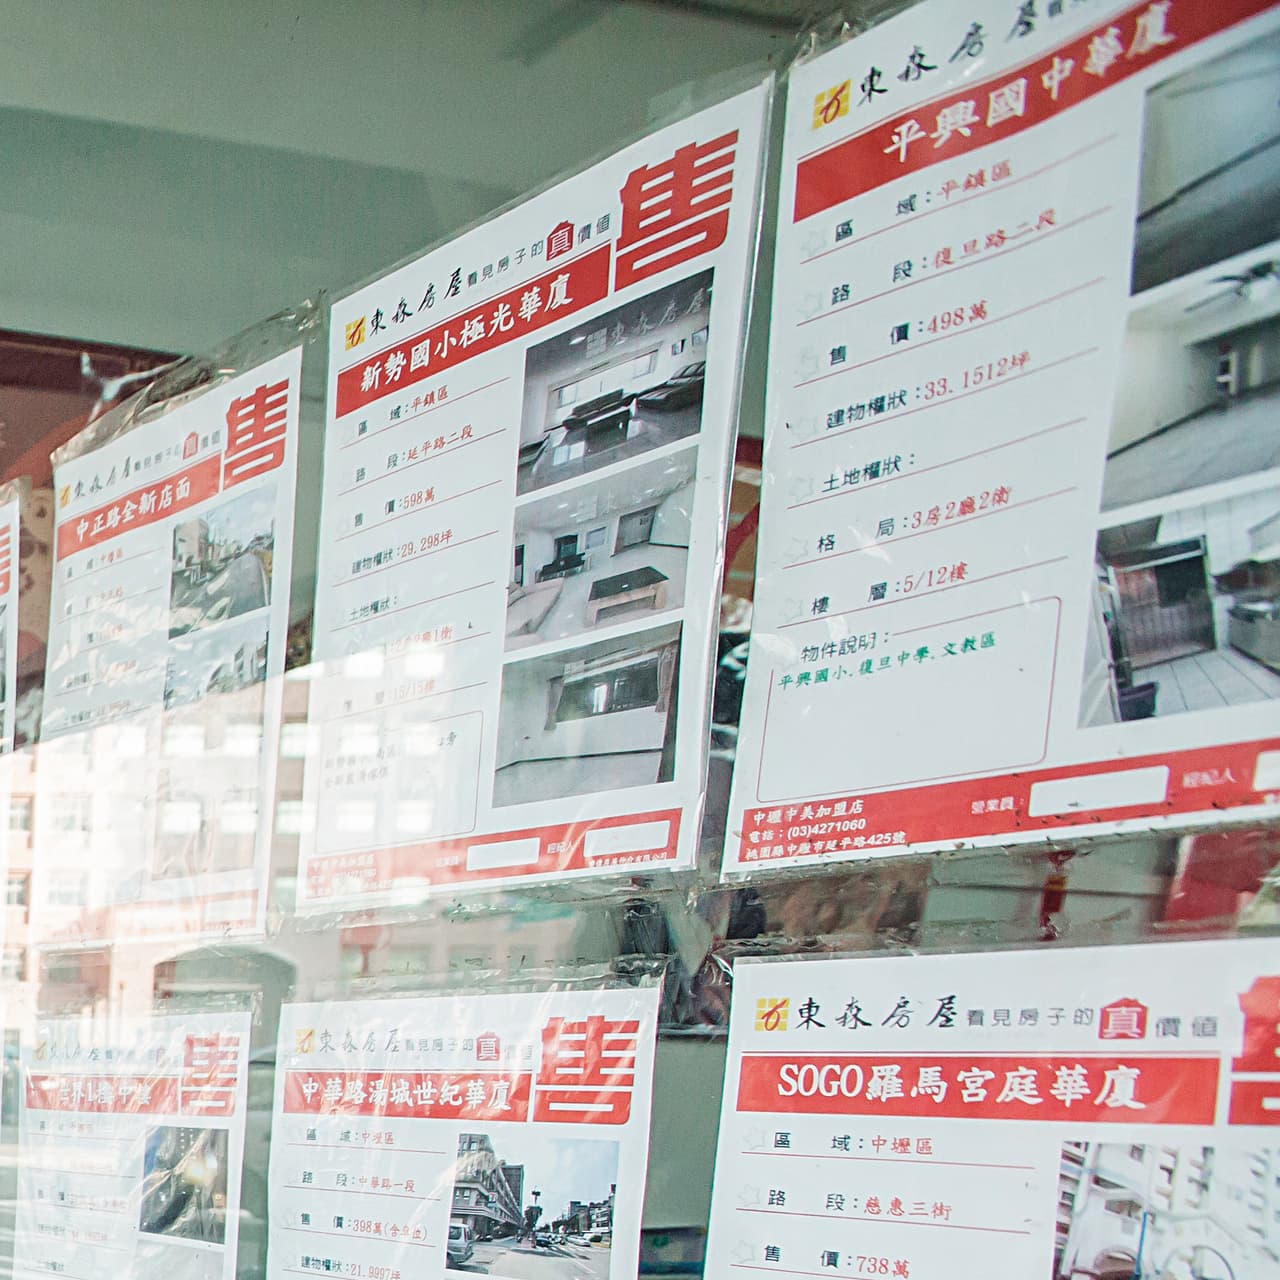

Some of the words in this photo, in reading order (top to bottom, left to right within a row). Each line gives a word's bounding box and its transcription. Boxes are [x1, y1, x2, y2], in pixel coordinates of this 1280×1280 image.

[883, 1, 1176, 162] 平興國中華廈
[614, 128, 739, 293] 售
[835, 219, 854, 242] 區
[832, 283, 850, 306] 路
[360, 273, 573, 393] 新勢國小極光華廈
[829, 344, 847, 366] 售
[224, 377, 290, 489] 售
[76, 476, 190, 542] 中正路全新店面
[816, 532, 836, 554] 格
[811, 595, 830, 616] 樓
[796, 995, 959, 1030] 東森房屋
[535, 1015, 640, 1125] 售
[777, 1062, 1147, 1109] SOGO羅馬宮庭華廈
[302, 1077, 512, 1111] 中華路湯城世紀華廈
[773, 1131, 791, 1149] 區
[768, 1190, 786, 1208] 路
[763, 1245, 781, 1263] 售
